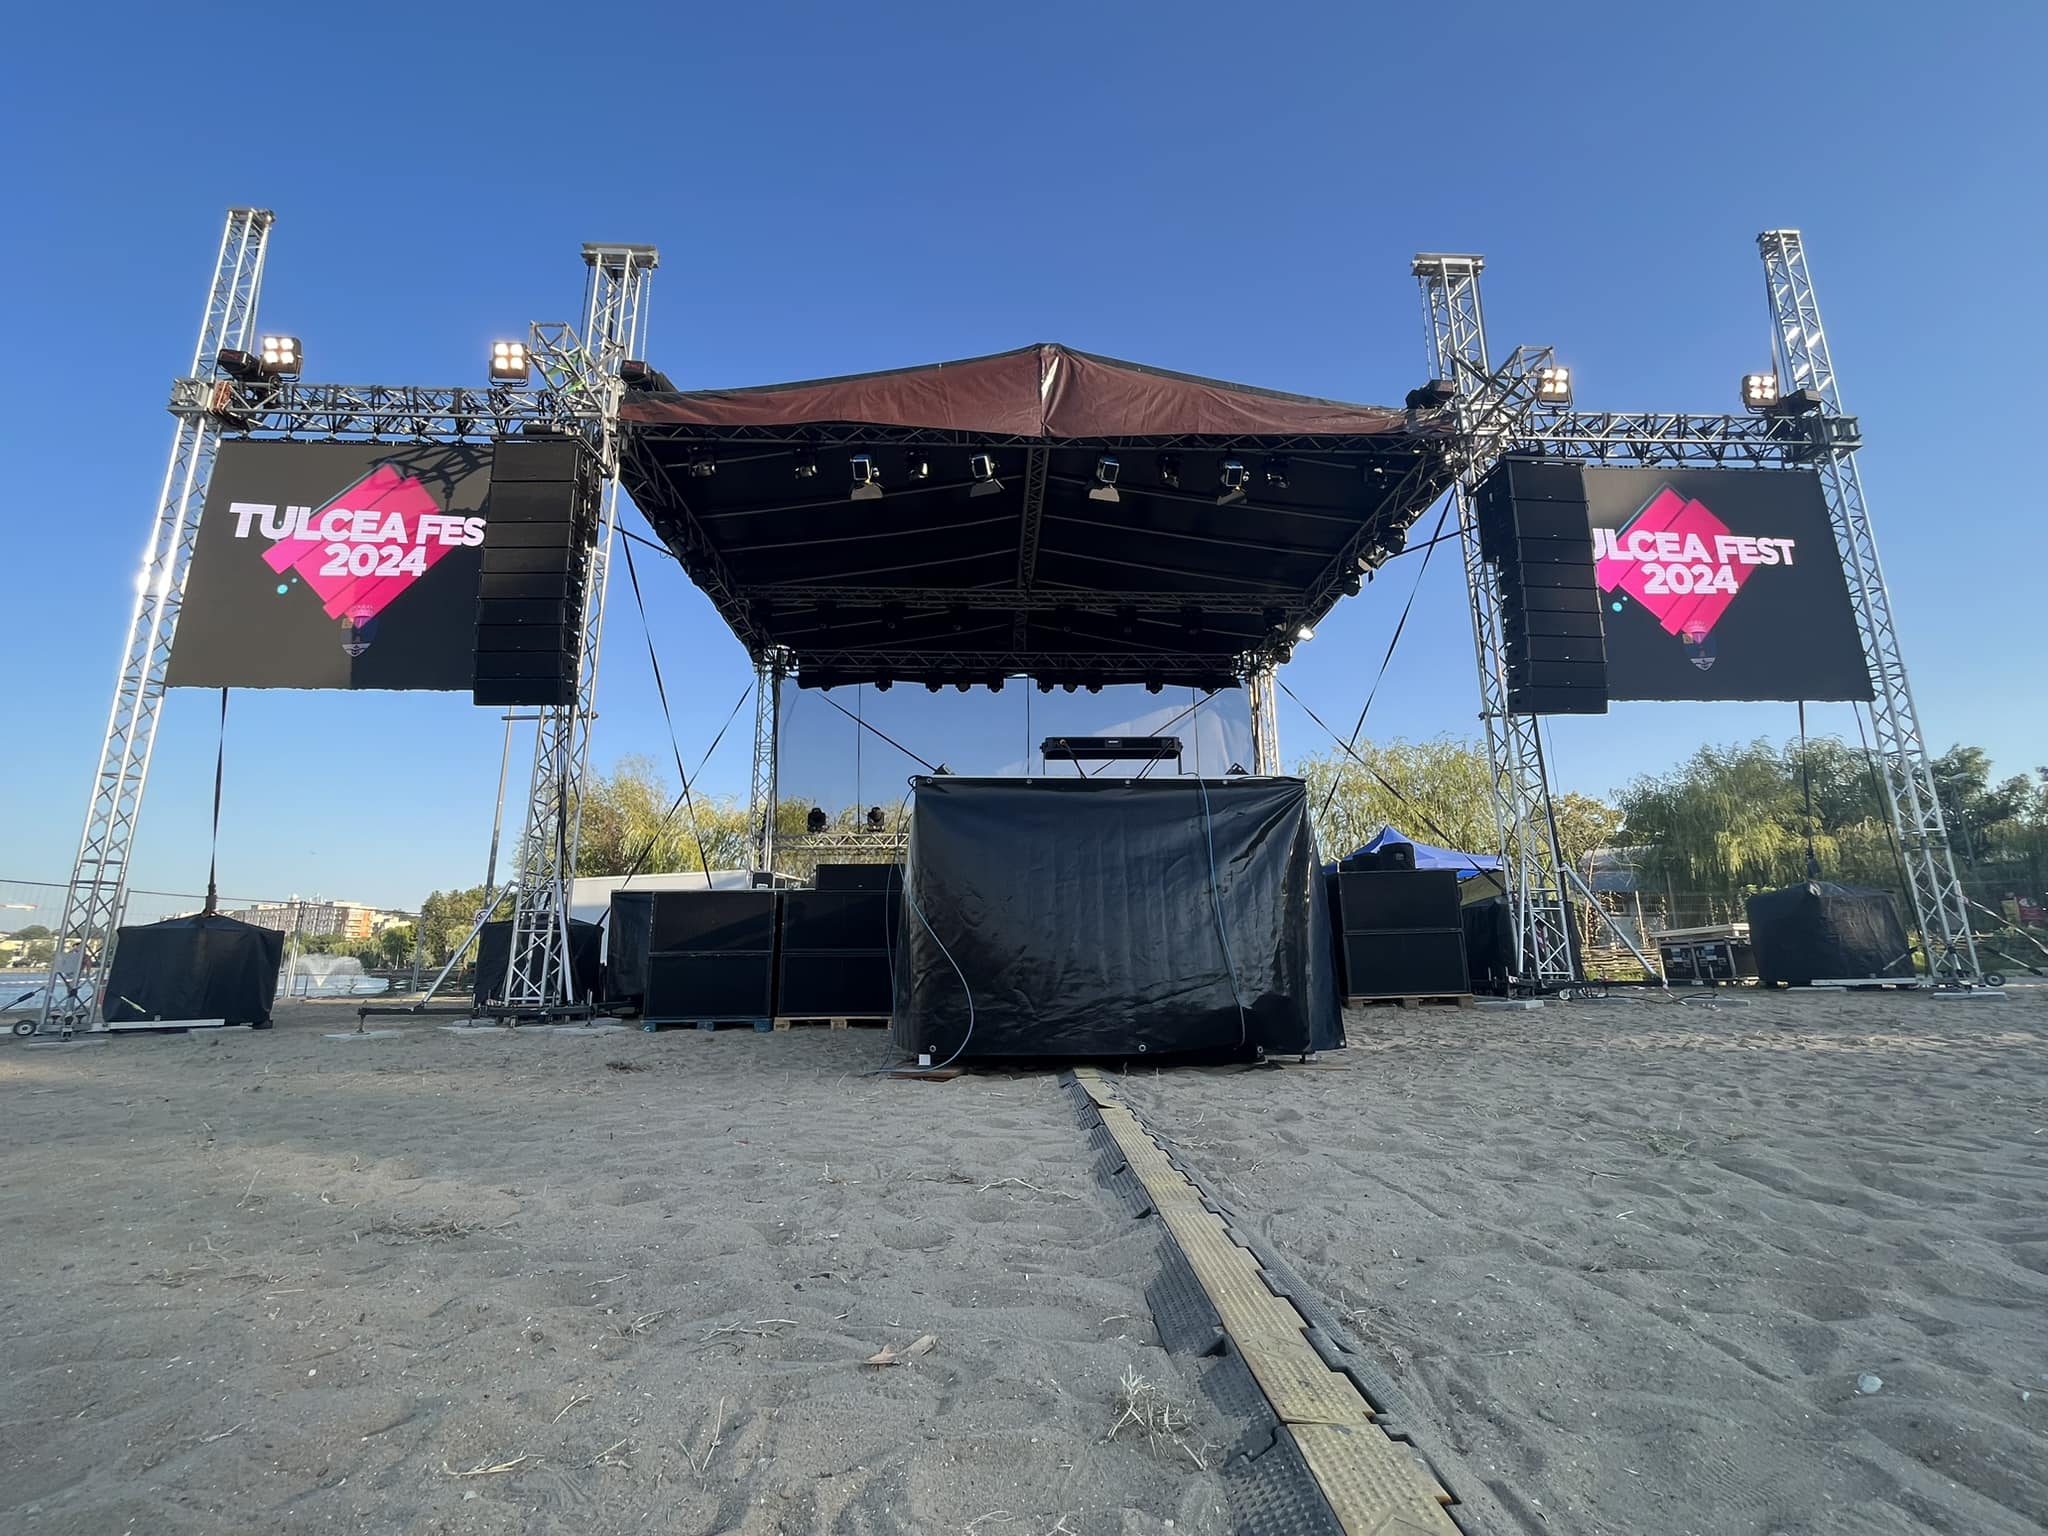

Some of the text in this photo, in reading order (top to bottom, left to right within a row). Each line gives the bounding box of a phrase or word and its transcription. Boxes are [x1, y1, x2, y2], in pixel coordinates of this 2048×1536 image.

[229, 502, 487, 547] TULCEA FES
[319, 543, 427, 577] 2024
[1592, 528, 1795, 565] LCEA FEST
[1641, 563, 1739, 594] 2024
